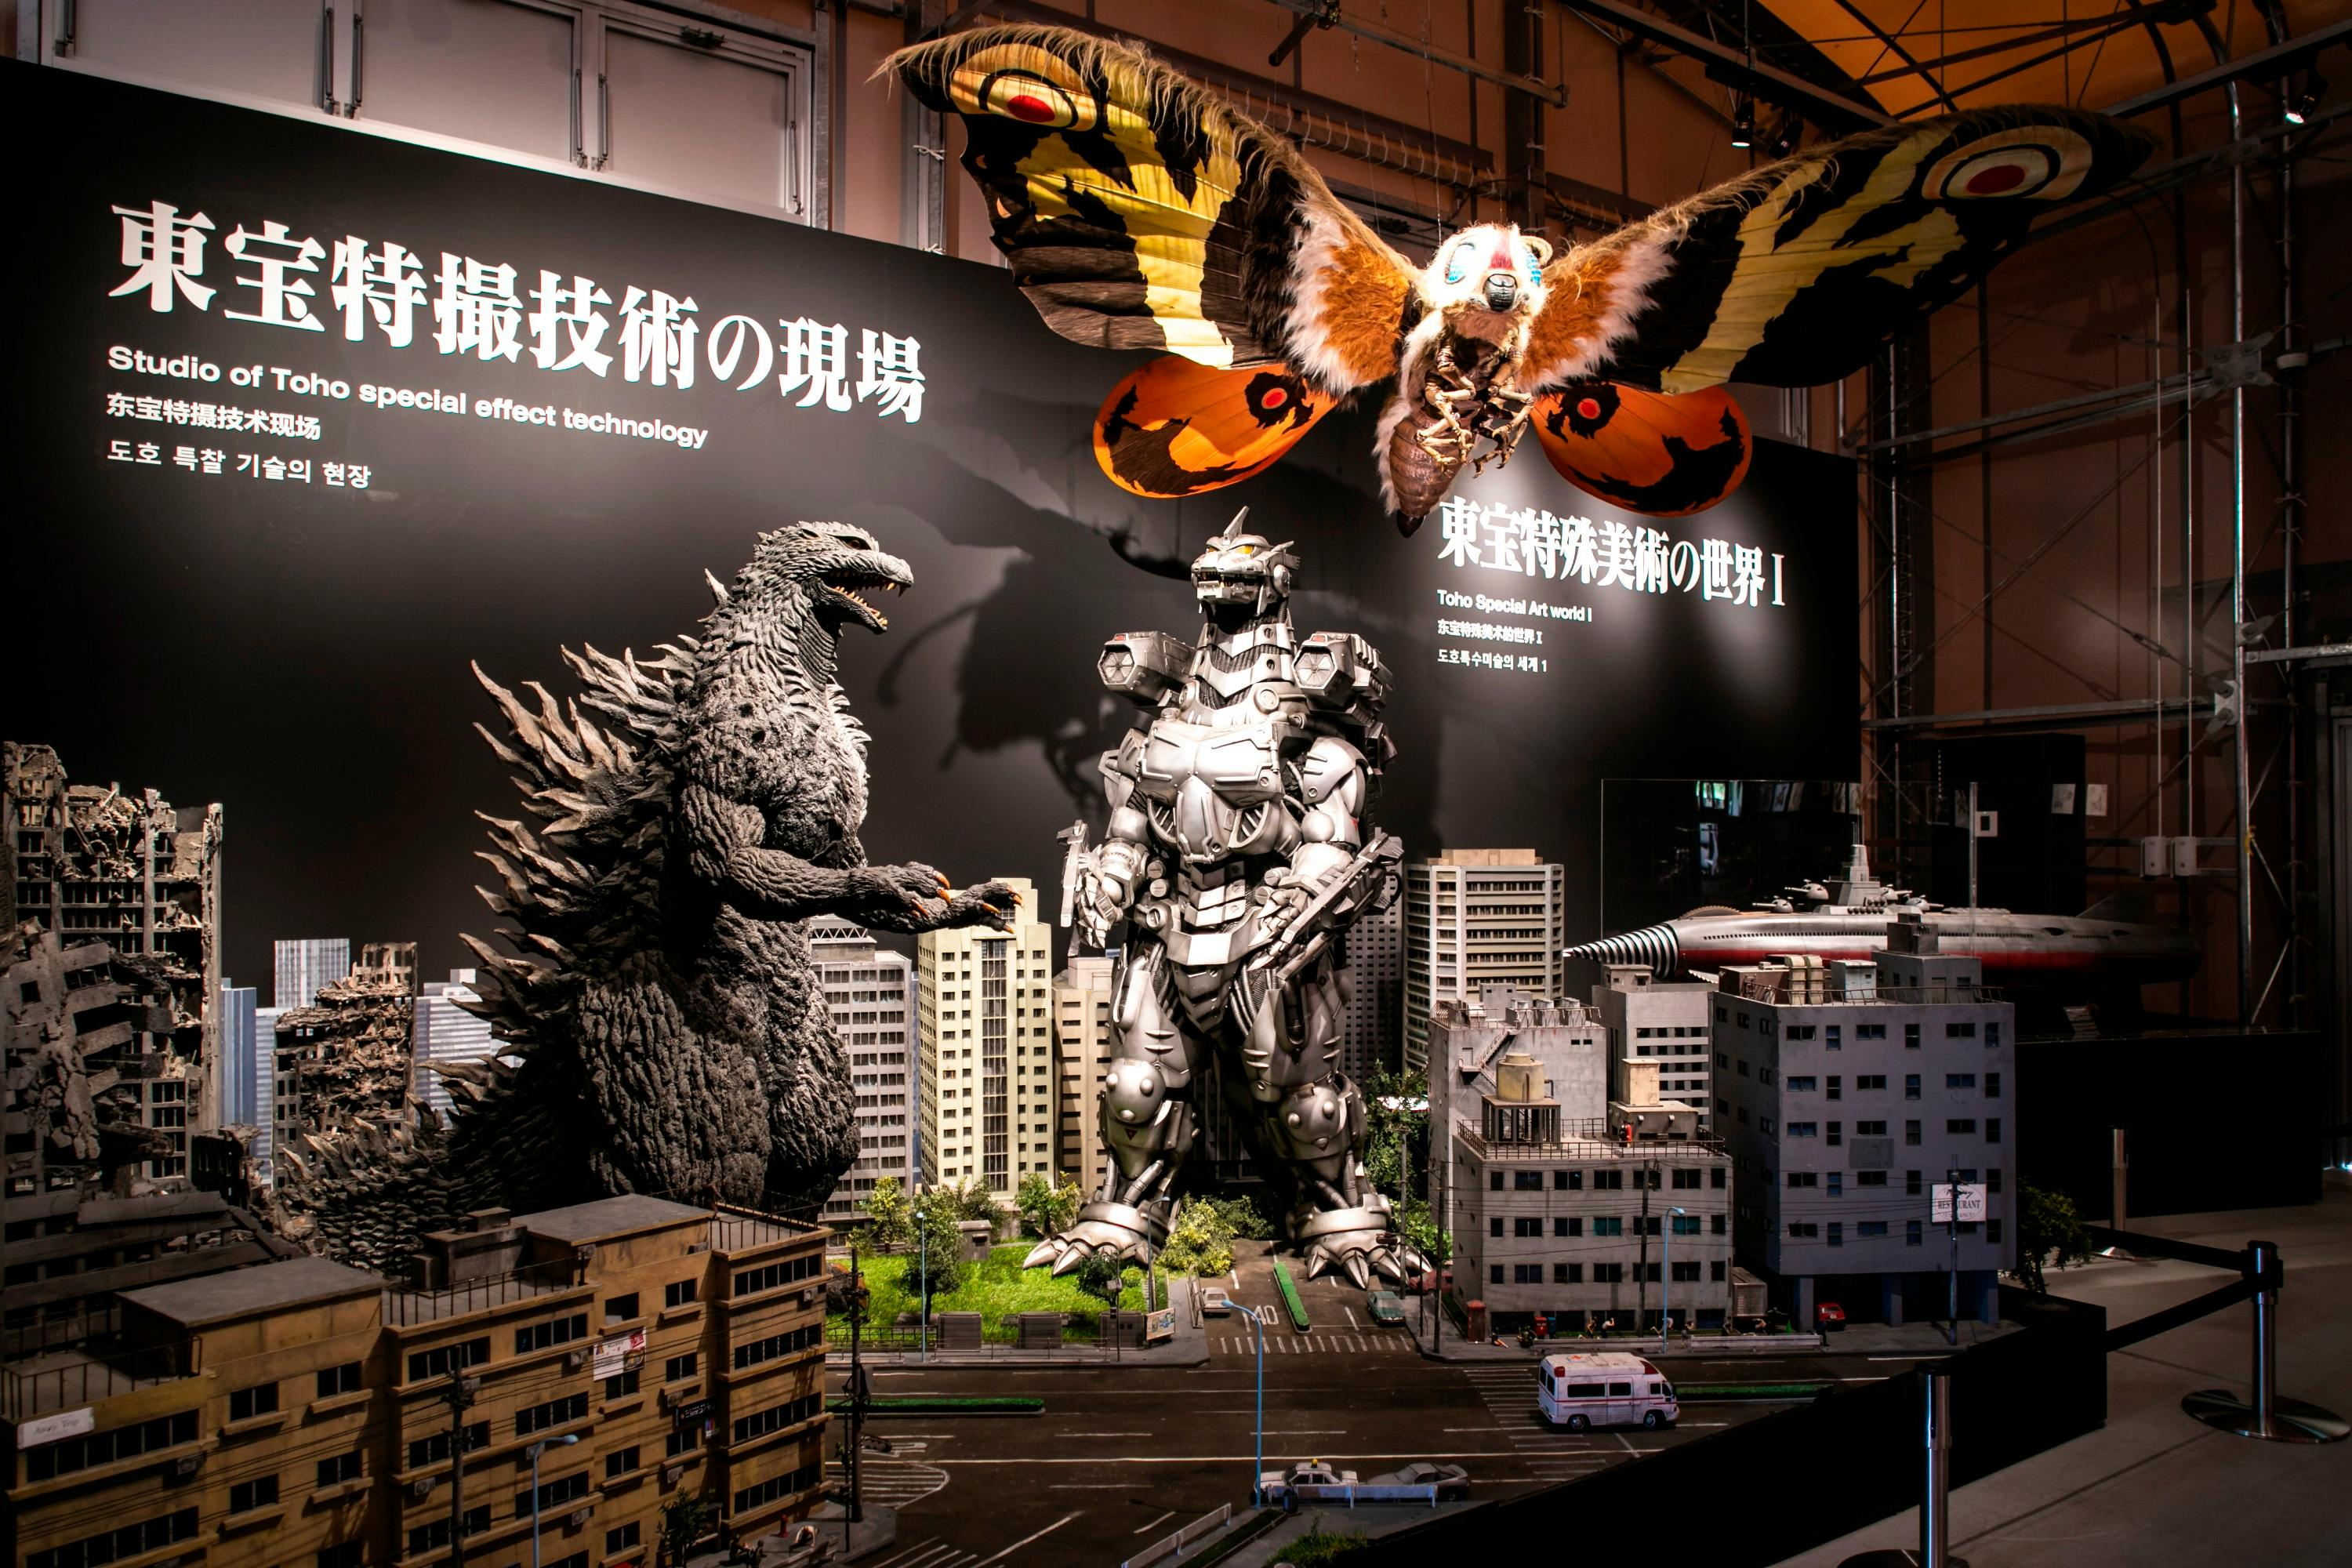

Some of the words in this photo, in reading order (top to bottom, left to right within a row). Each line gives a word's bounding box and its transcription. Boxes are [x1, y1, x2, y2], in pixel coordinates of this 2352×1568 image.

[107, 201, 926, 423] 東宝特撮技術の現場
[107, 392, 321, 441] 东宝特摄技术现场
[108, 346, 220, 382] Studio
[230, 365, 263, 388] of
[271, 367, 350, 399] Toho
[358, 383, 467, 415] special
[474, 397, 557, 427] effect
[562, 407, 709, 449] technology
[107, 440, 162, 465] 도호
[172, 446, 227, 474] 특찰
[236, 453, 311, 484] 기술의
[321, 461, 372, 488] 현장
[1437, 589, 1473, 608] Toho
[1475, 594, 1526, 614] Special
[1528, 600, 1548, 618] Art
[1549, 605, 1585, 622] world
